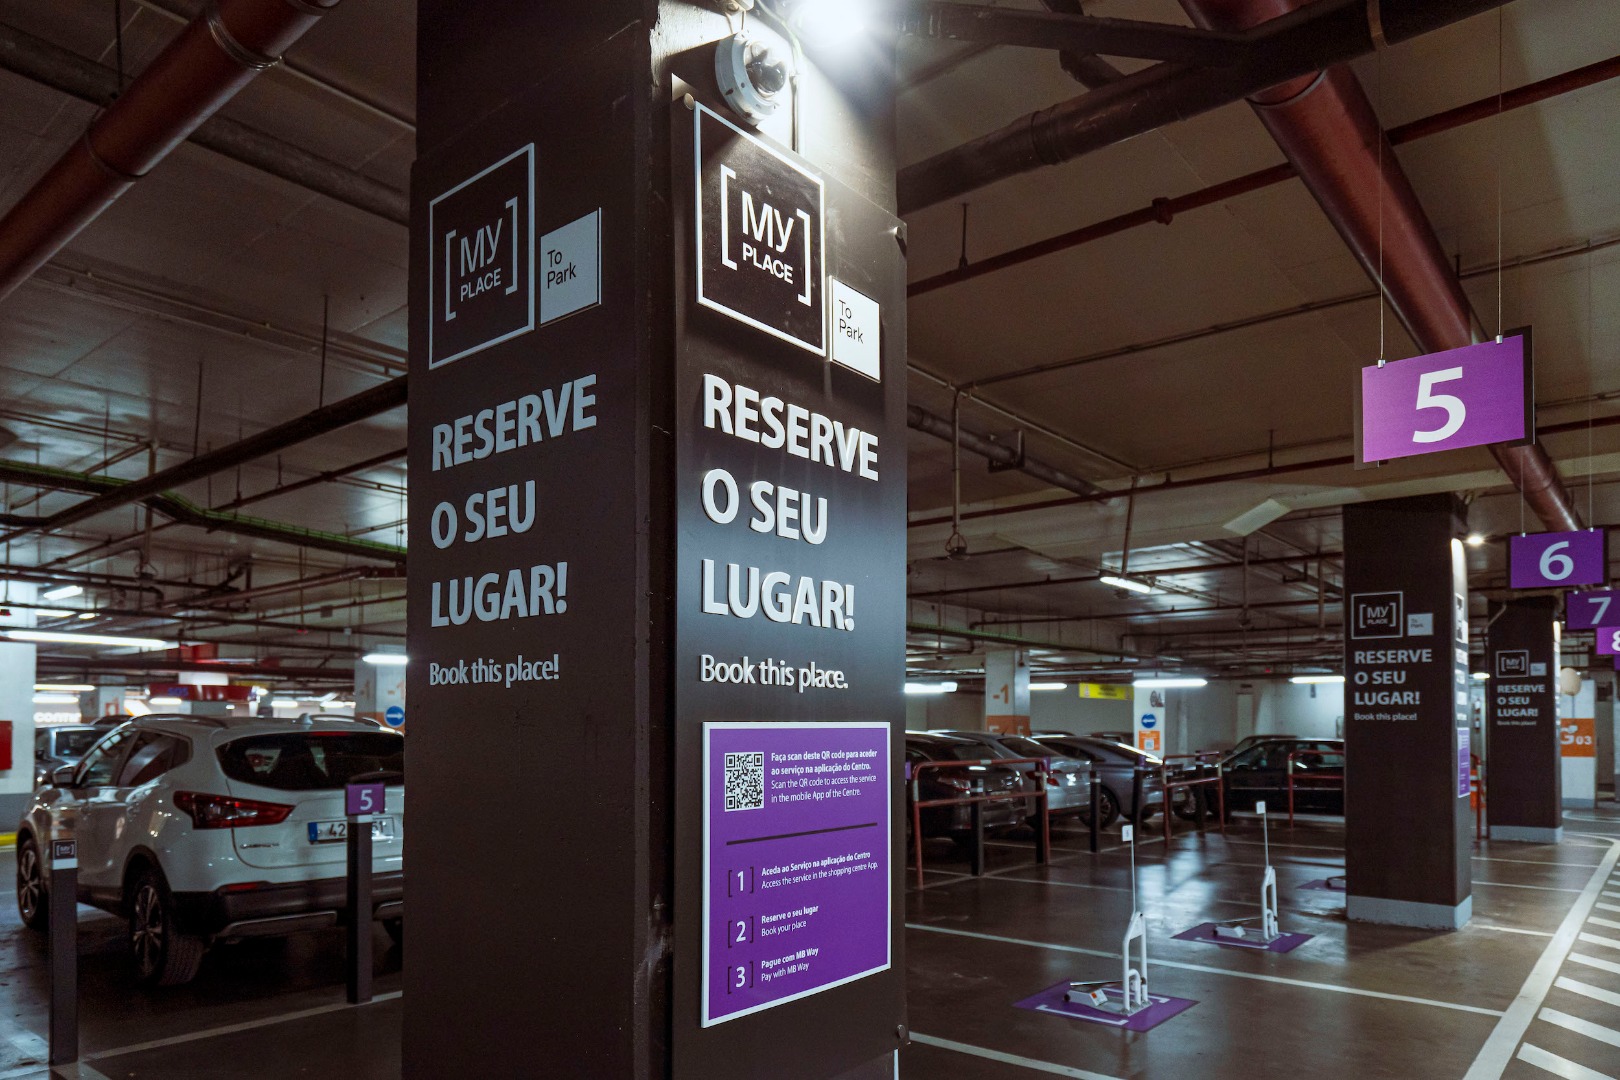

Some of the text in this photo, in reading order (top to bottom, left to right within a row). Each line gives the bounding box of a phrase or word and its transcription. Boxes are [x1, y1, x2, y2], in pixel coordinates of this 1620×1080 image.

[742, 191, 794, 253] MY
[460, 218, 502, 277] MY
[547, 249, 562, 268] To
[742, 242, 793, 284] PLACE
[460, 268, 501, 301] PLACE
[547, 262, 576, 289] Park
[839, 300, 851, 320] To
[839, 319, 863, 344] Park
[1413, 366, 1466, 443] 5
[432, 374, 597, 471] RESERVE
[703, 374, 878, 481] RESERVE
[431, 480, 535, 549] O SEU
[702, 468, 827, 545] O SEU
[1539, 541, 1574, 580] 6
[431, 562, 567, 628] LUGAR!
[702, 559, 854, 631] LUGAR!
[1367, 606, 1389, 618] MY
[1588, 597, 1612, 624] 7
[1355, 649, 1432, 664] RESERVE
[430, 654, 558, 688] Book this place!
[701, 655, 848, 693] Book this place.
[1354, 671, 1406, 684] O SEU
[1355, 692, 1420, 705] LUGAR!
[772, 753, 786, 763] Faça
[803, 751, 820, 760] deste
[821, 751, 830, 760] QR
[832, 750, 844, 759] code
[846, 751, 858, 760] para
[860, 749, 877, 758] aceder
[781, 766, 804, 776] serviço
[852, 762, 871, 770] Centro.
[771, 780, 786, 789] Scan
[788, 779, 798, 788] the
[799, 778, 808, 787] QR
[809, 778, 822, 786] code
[360, 790, 372, 810] 5
[772, 795, 777, 803] in
[779, 793, 789, 802] the
[791, 792, 811, 801] mobile
[813, 791, 824, 801] App
[826, 790, 831, 798] of
[832, 789, 841, 797] the
[329, 823, 346, 836] 42
[737, 871, 744, 892] 1
[762, 867, 780, 876] Aceda
[762, 880, 781, 889] Access
[782, 877, 791, 885] the
[793, 874, 811, 883] service
[819, 870, 827, 878] the
[828, 866, 851, 876] shopping
[852, 863, 866, 872] centre
[762, 913, 785, 924] Reserve
[804, 906, 818, 915] lugar
[736, 921, 746, 942] 2
[762, 920, 806, 936] Book your place
[762, 948, 818, 969] Pague com MB Way
[736, 967, 746, 988] 3
[762, 963, 809, 981] Pay with MB Way
